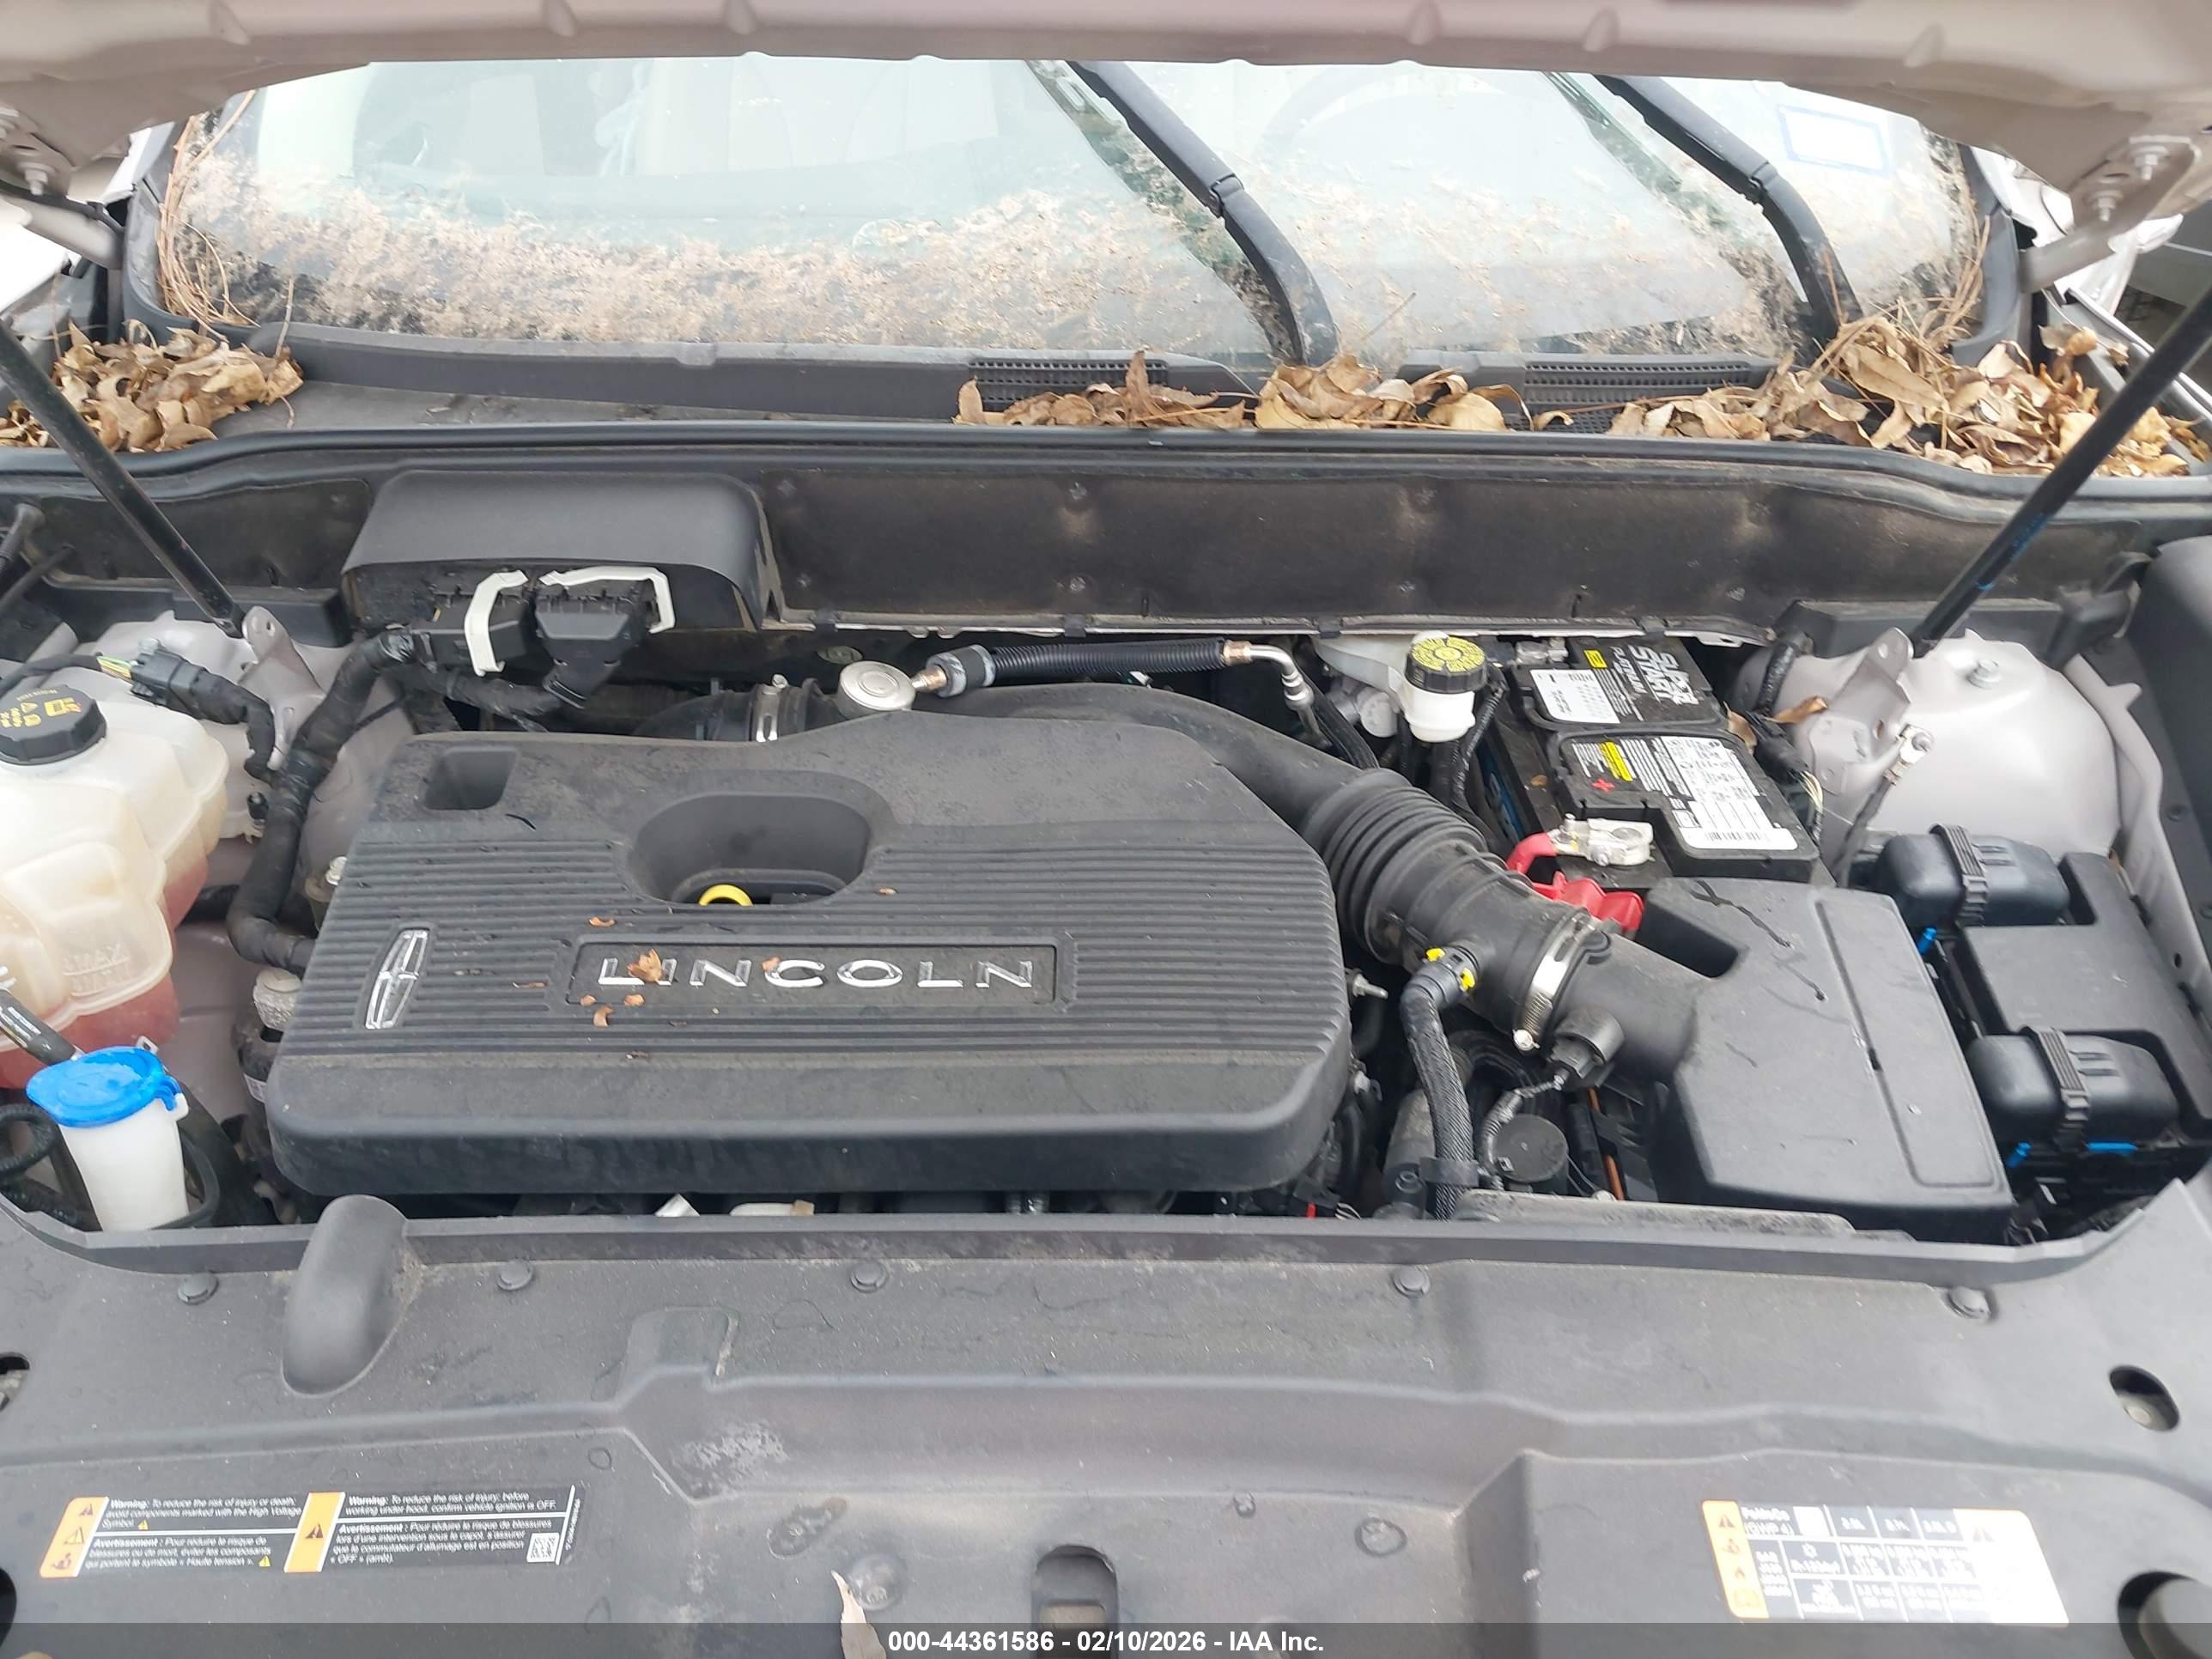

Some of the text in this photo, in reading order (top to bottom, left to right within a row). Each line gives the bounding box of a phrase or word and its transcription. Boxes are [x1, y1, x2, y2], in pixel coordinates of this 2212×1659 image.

[1609, 646, 1648, 694] PLATINUM
[1628, 645, 1675, 702] START
[599, 957, 1034, 988] LINCOLN
[338, 1523, 404, 1534] Avertissement
